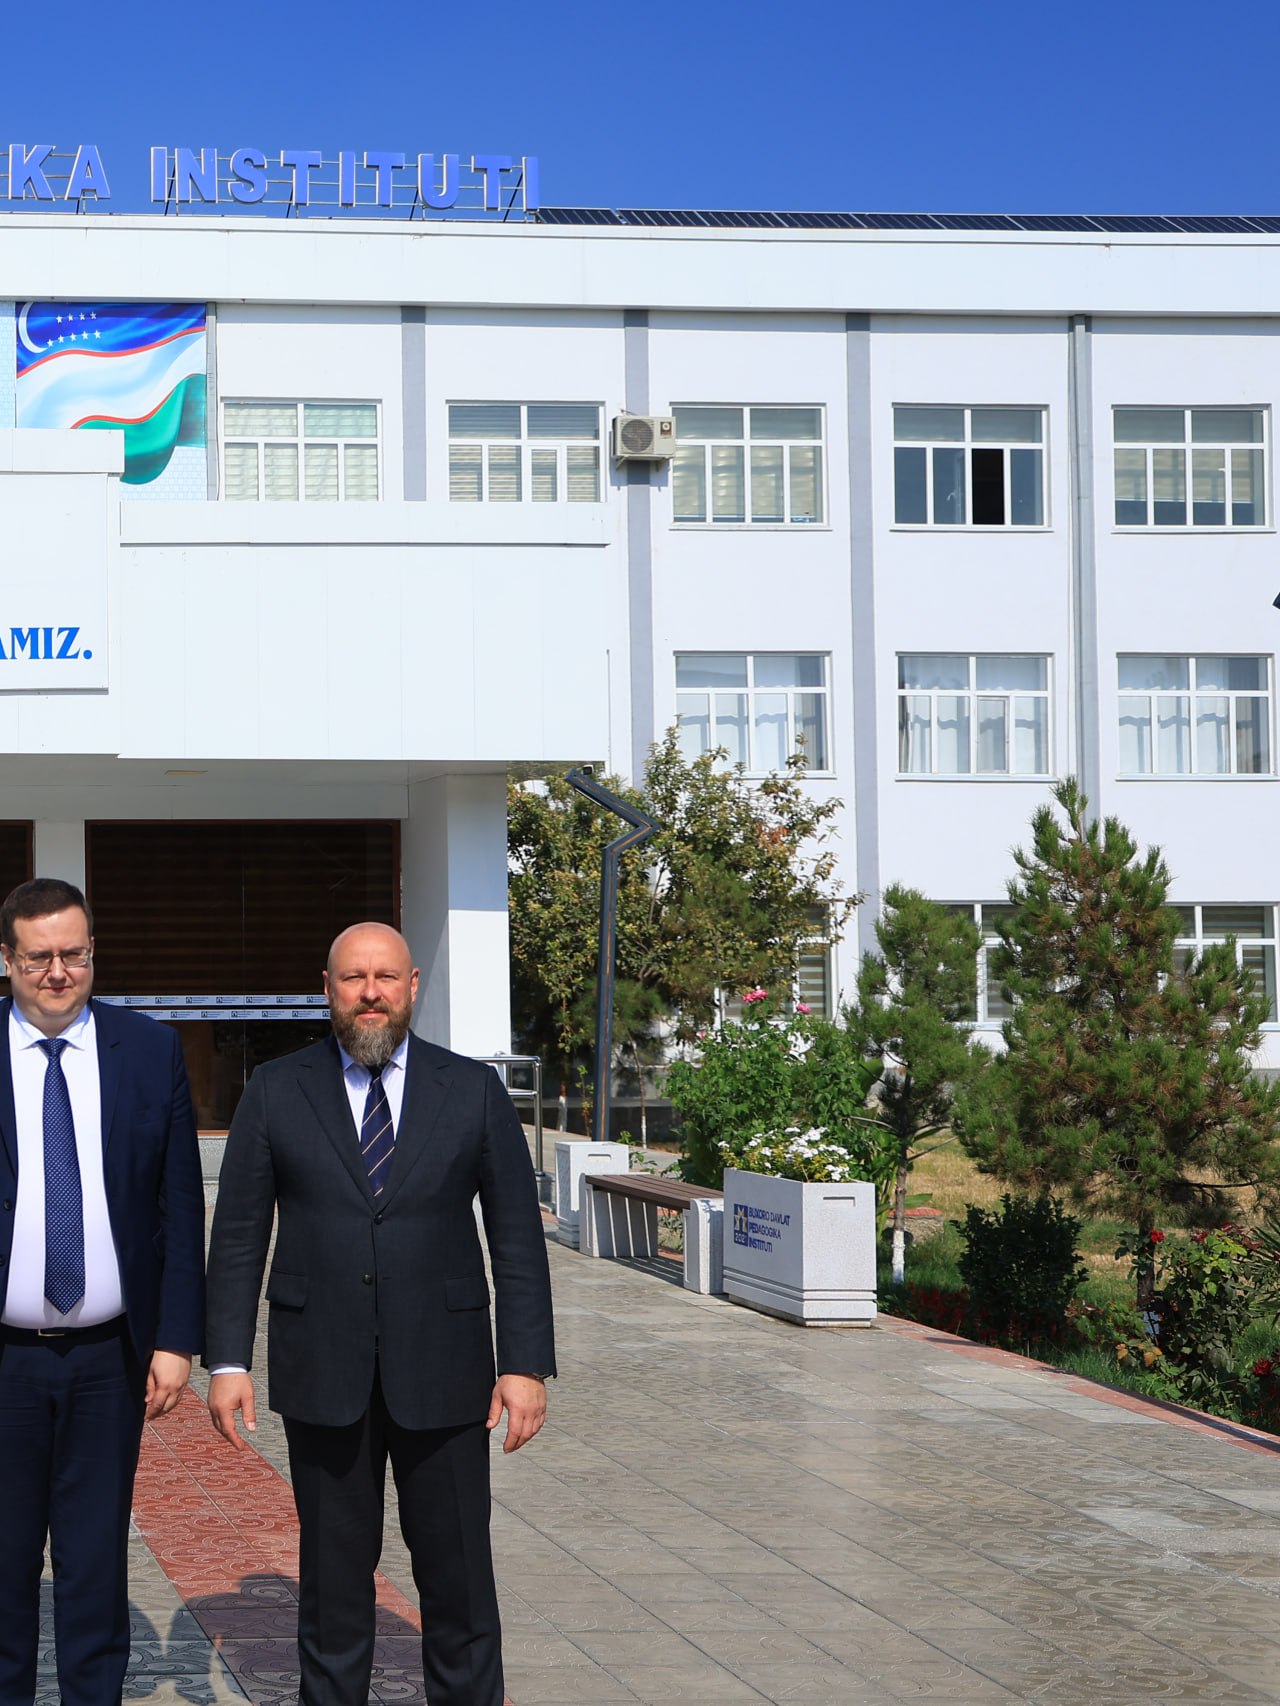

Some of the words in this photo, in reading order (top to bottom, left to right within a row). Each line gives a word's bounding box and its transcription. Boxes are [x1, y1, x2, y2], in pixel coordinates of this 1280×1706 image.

[150, 146, 540, 213] INSTITUTI
[748, 1206, 769, 1221] BUXORO
[770, 1211, 791, 1227] DAVLAT
[748, 1222, 782, 1240] PEDAGOGIKA
[748, 1237, 773, 1253] INSTITUTI
